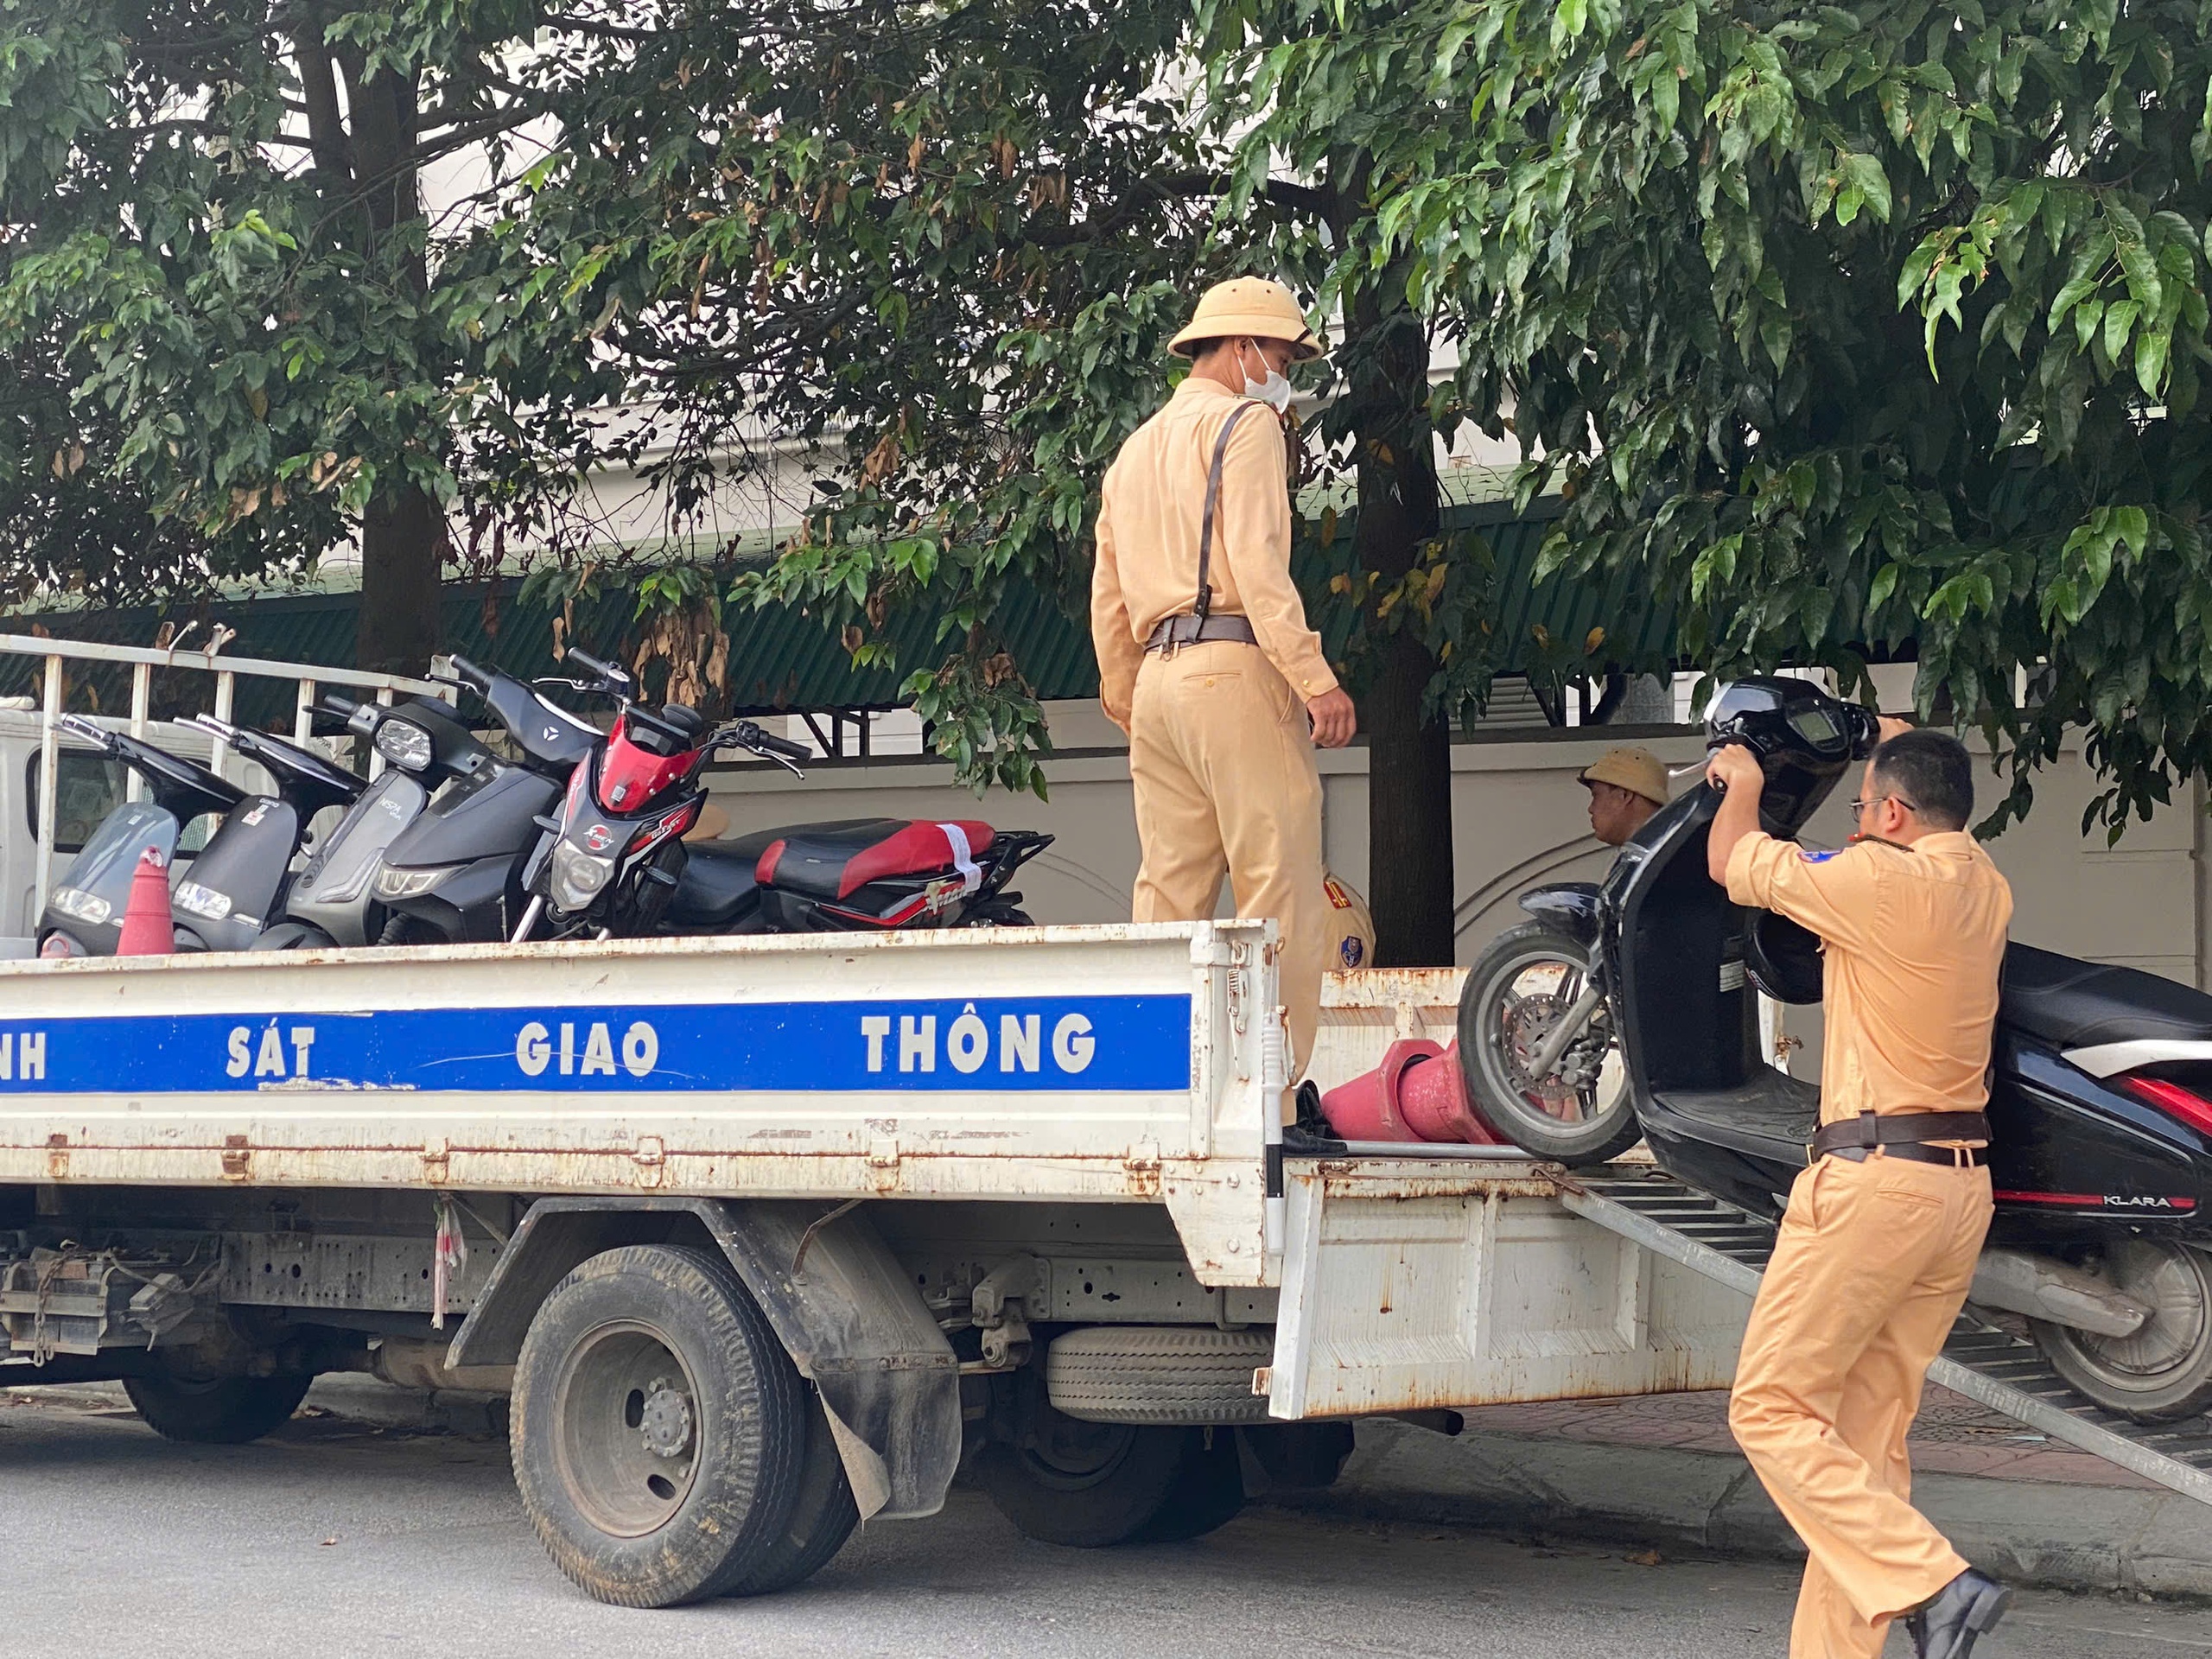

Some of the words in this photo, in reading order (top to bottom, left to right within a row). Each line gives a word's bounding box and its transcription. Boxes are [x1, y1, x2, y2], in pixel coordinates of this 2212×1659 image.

[226, 1017, 315, 1078] SÁT
[515, 1020, 659, 1077] GIAO
[861, 1001, 1096, 1074] THÔNG
[2103, 1195, 2171, 1208] KLARA
